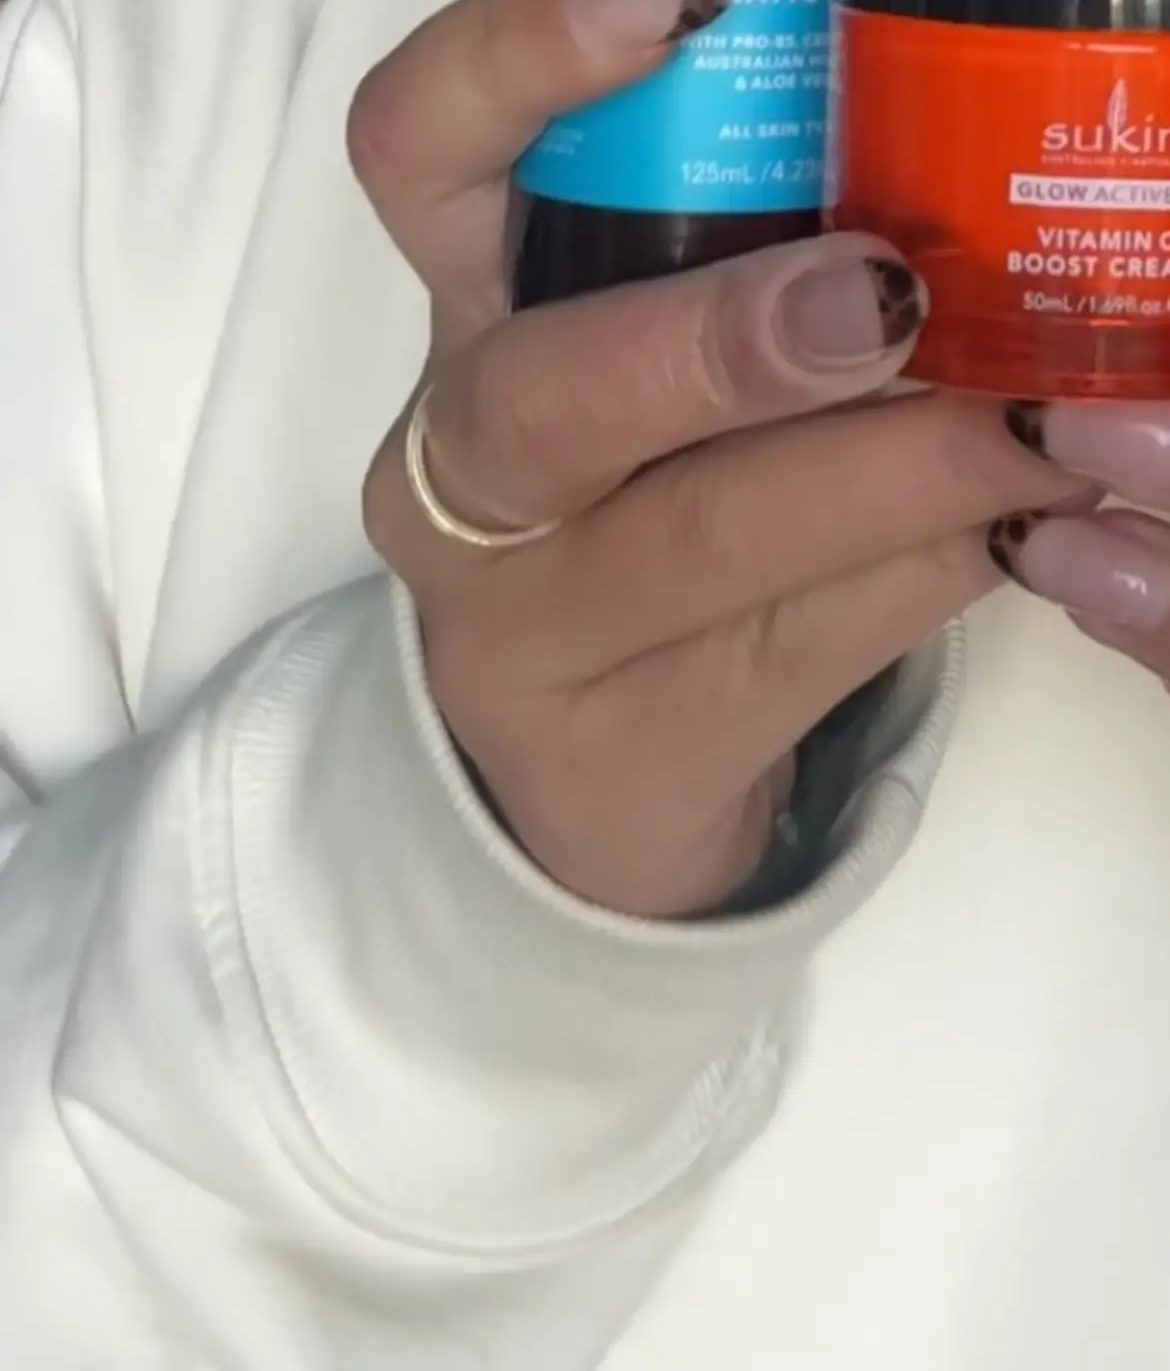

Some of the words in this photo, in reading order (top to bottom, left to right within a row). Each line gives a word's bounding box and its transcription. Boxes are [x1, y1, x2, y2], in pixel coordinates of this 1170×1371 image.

[719, 123, 753, 140] ALL
[680, 161, 756, 184] 125mL
[1016, 180, 1089, 201] GLOW
[1037, 227, 1154, 251] VITAMIN
[1007, 251, 1099, 277] BOOST
[1022, 290, 1073, 311] 50mL
